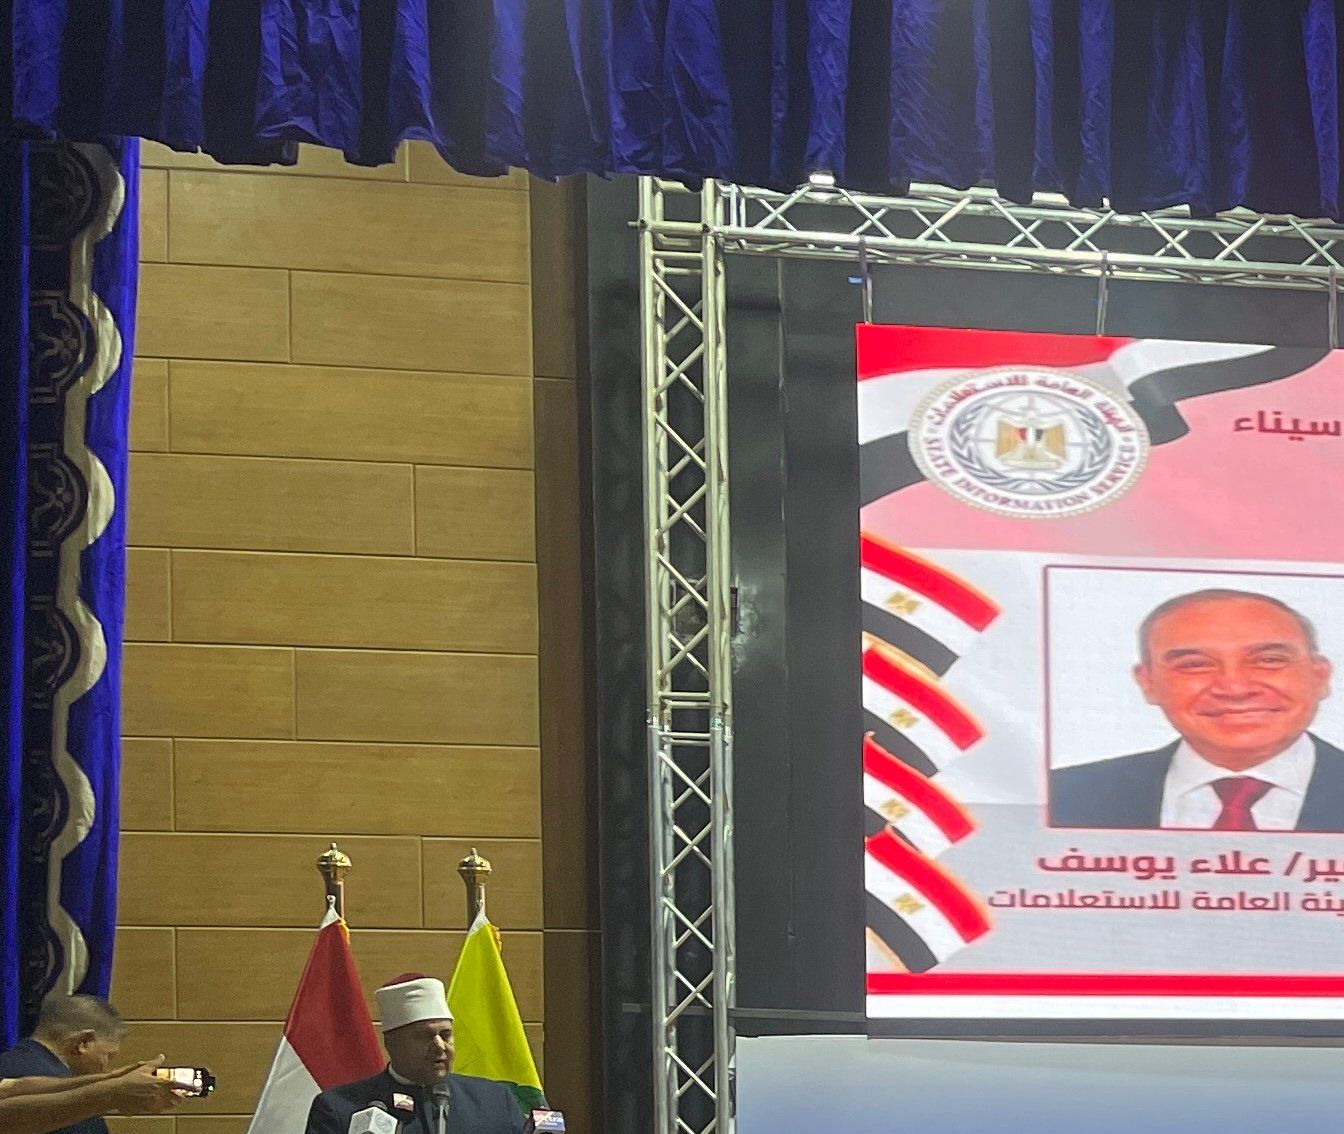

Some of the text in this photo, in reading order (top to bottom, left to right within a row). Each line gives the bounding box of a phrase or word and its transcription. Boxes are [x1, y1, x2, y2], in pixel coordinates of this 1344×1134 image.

[1233, 410, 1341, 442] سيناء
[1038, 848, 1177, 880] يوسف
[1190, 850, 1271, 876] علاء
[987, 889, 1180, 911] للاستعلامات
[1192, 890, 1289, 912] العامة
